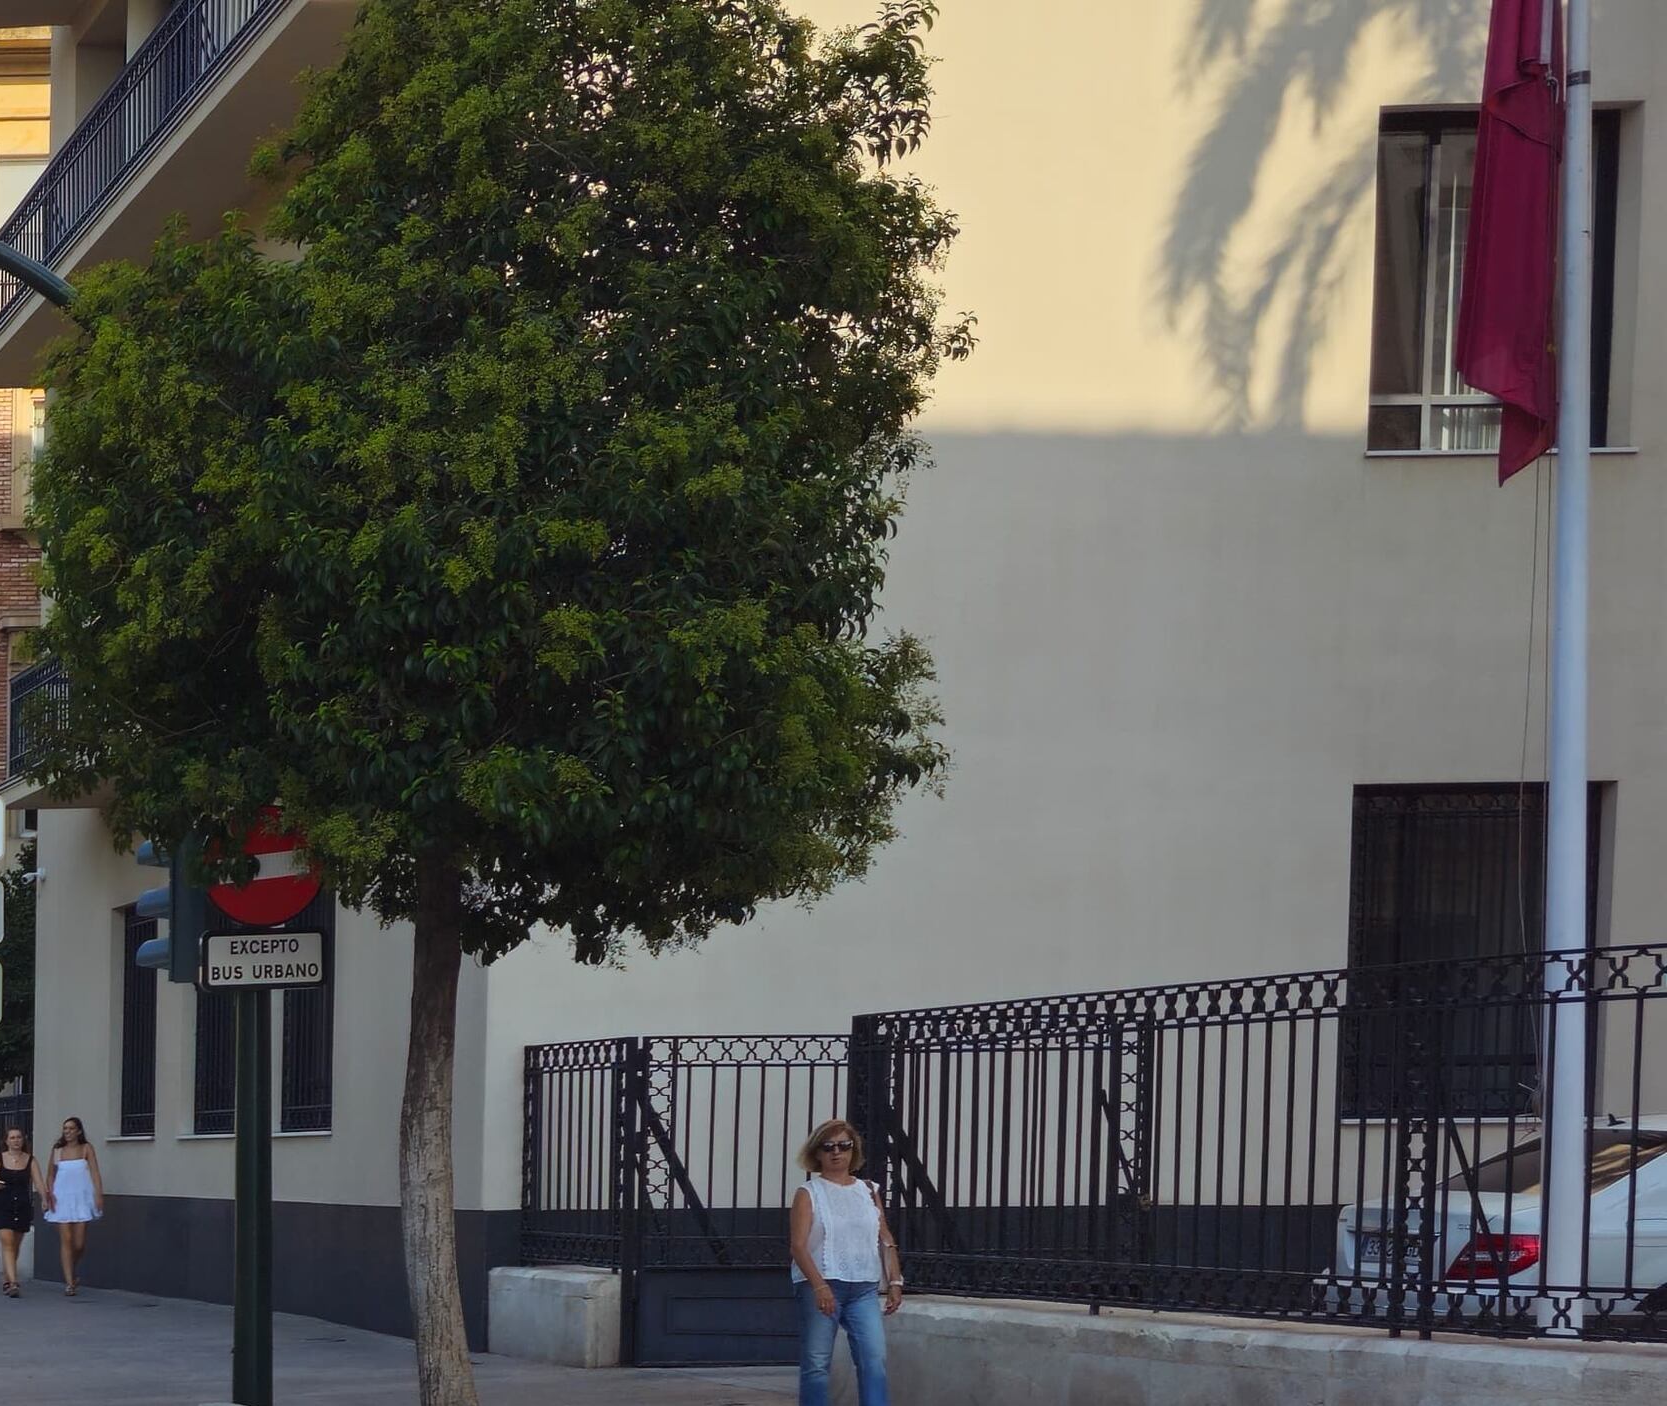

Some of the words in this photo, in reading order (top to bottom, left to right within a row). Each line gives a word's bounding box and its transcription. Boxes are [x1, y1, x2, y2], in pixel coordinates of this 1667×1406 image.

[230, 938, 299, 955] EXCEPTO
[211, 965, 243, 980] BUS
[252, 962, 319, 979] URBANO
